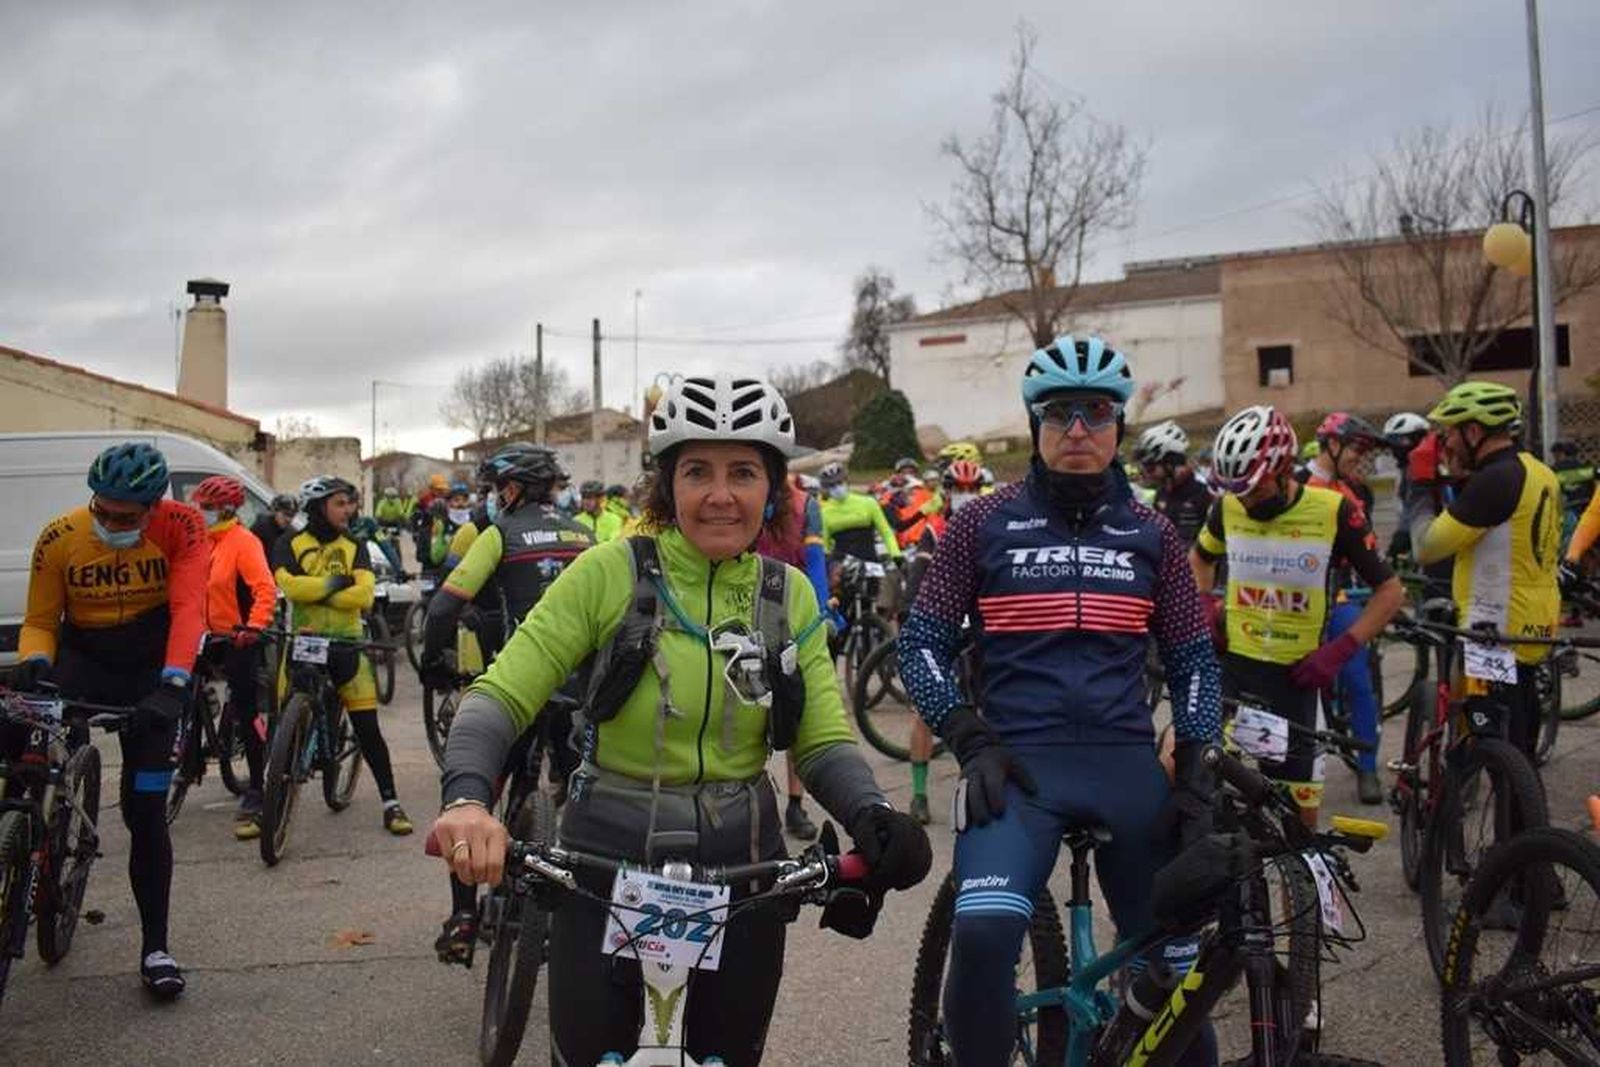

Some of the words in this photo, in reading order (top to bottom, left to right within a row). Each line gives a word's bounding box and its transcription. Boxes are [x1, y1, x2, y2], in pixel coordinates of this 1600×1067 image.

[1006, 545, 1135, 568] TREK
[67, 563, 130, 588] LENG
[1082, 564, 1135, 582] RACING
[1257, 725, 1273, 745] 2
[633, 903, 713, 944] 202
